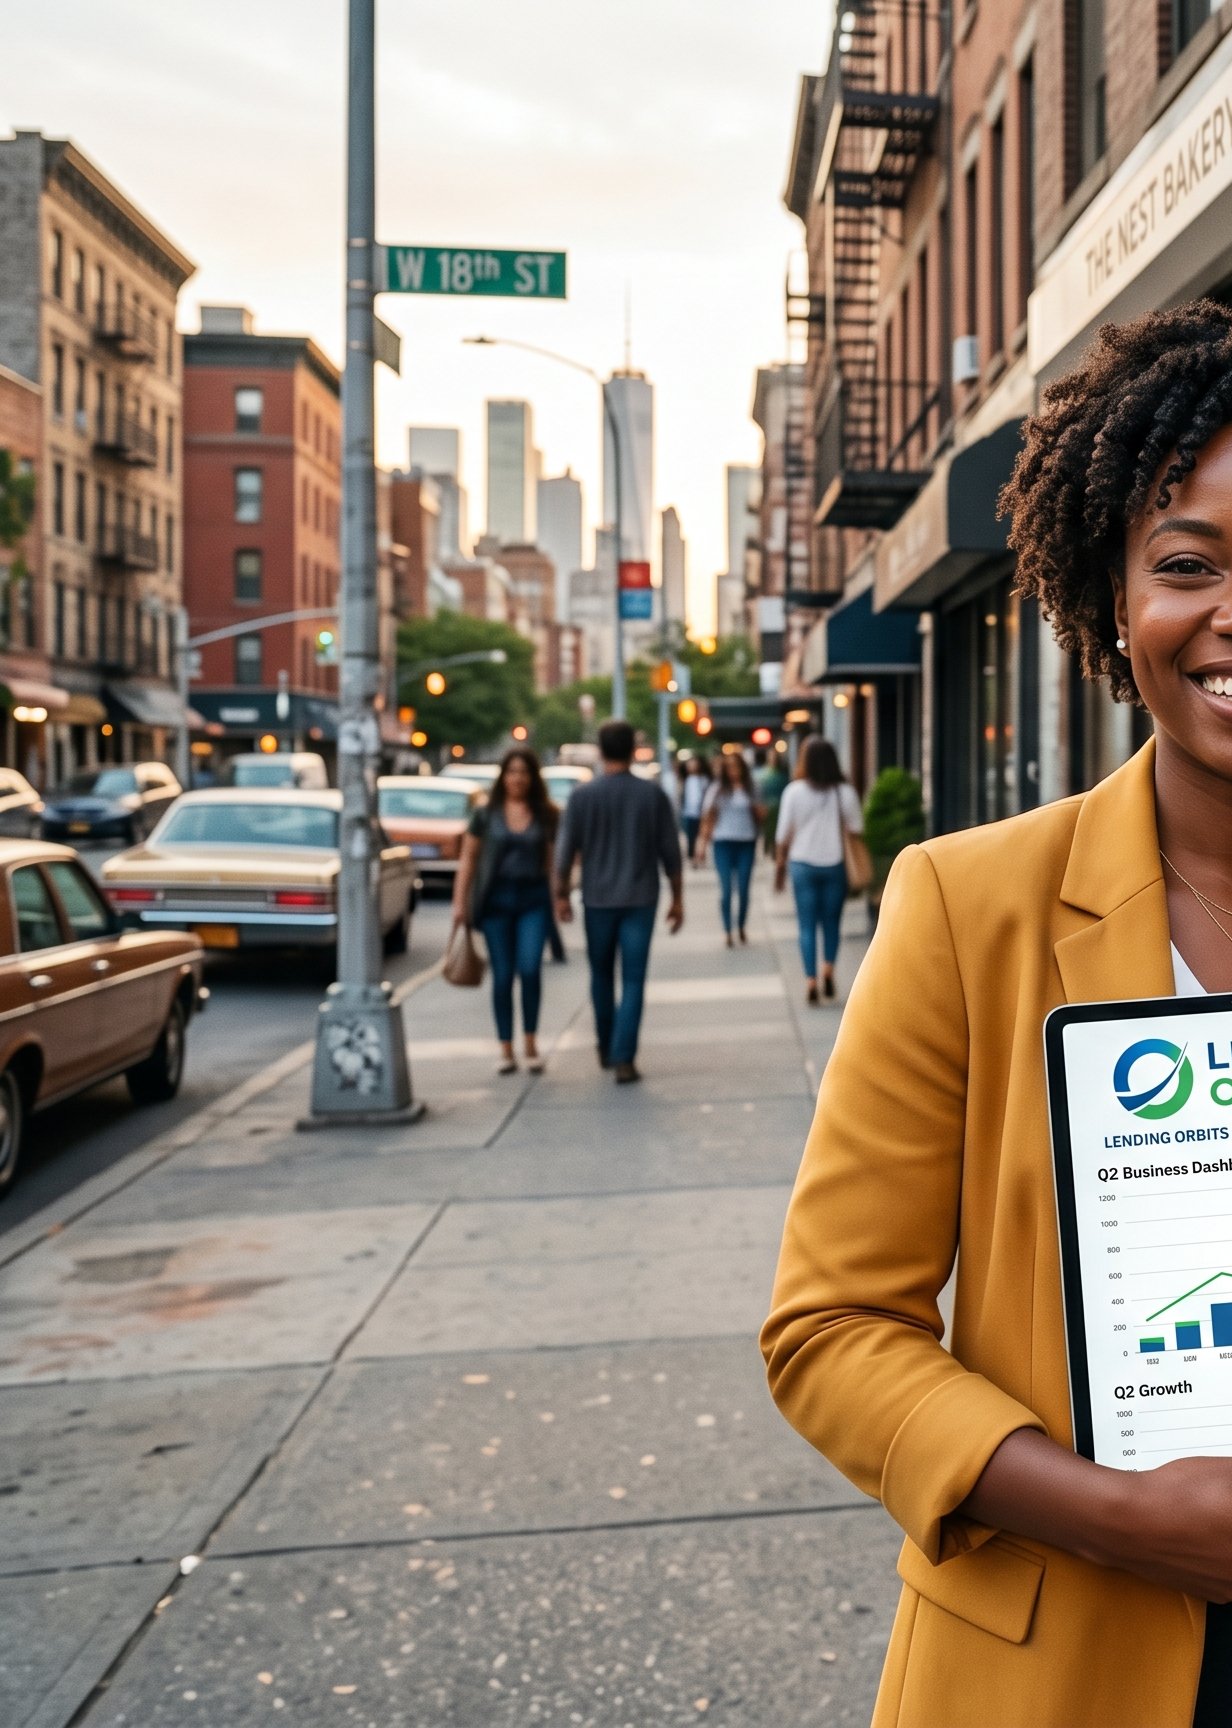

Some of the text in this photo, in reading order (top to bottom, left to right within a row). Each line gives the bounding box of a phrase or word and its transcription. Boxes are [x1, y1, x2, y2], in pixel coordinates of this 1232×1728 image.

[1085, 227, 1113, 298] THE
[1117, 179, 1158, 262] NEST
[396, 250, 554, 294] W 18th ST
[1104, 1131, 1171, 1149] LENDING
[1174, 1127, 1229, 1143] ORBITS
[1097, 1167, 1119, 1183] Q2
[1123, 1164, 1189, 1180] Business
[1098, 1194, 1116, 1202] 1200
[1100, 1220, 1119, 1228] 1000
[1107, 1246, 1121, 1254] 800
[1108, 1272, 1122, 1280] 600
[1111, 1298, 1125, 1306] 400
[1113, 1324, 1127, 1332] 200
[1122, 1350, 1128, 1358] 0
[1114, 1380, 1193, 1400] Q2 Growth
[1116, 1410, 1133, 1418] 1000
